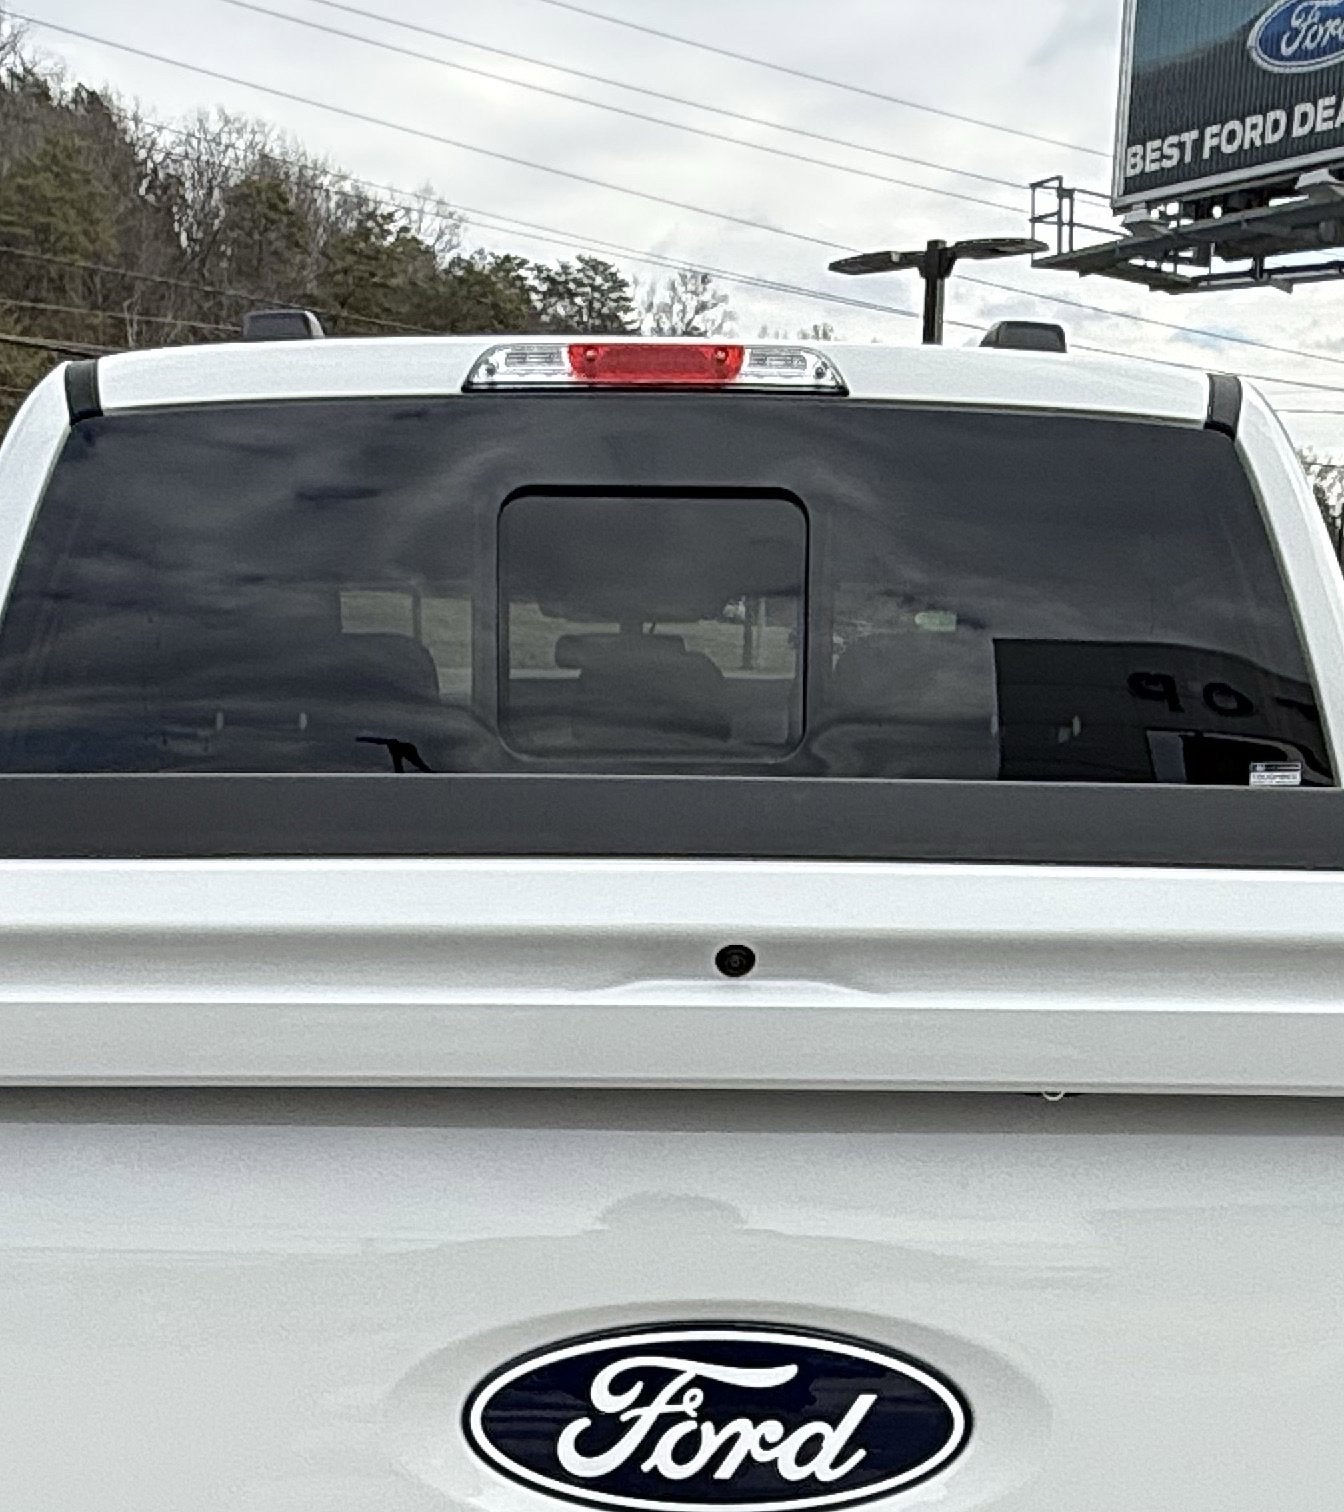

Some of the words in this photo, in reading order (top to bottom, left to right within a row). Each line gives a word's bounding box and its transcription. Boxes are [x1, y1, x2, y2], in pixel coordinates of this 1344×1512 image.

[1126, 128, 1200, 178] BEST
[1203, 109, 1288, 160] FORD
[556, 1356, 878, 1482] Ford
